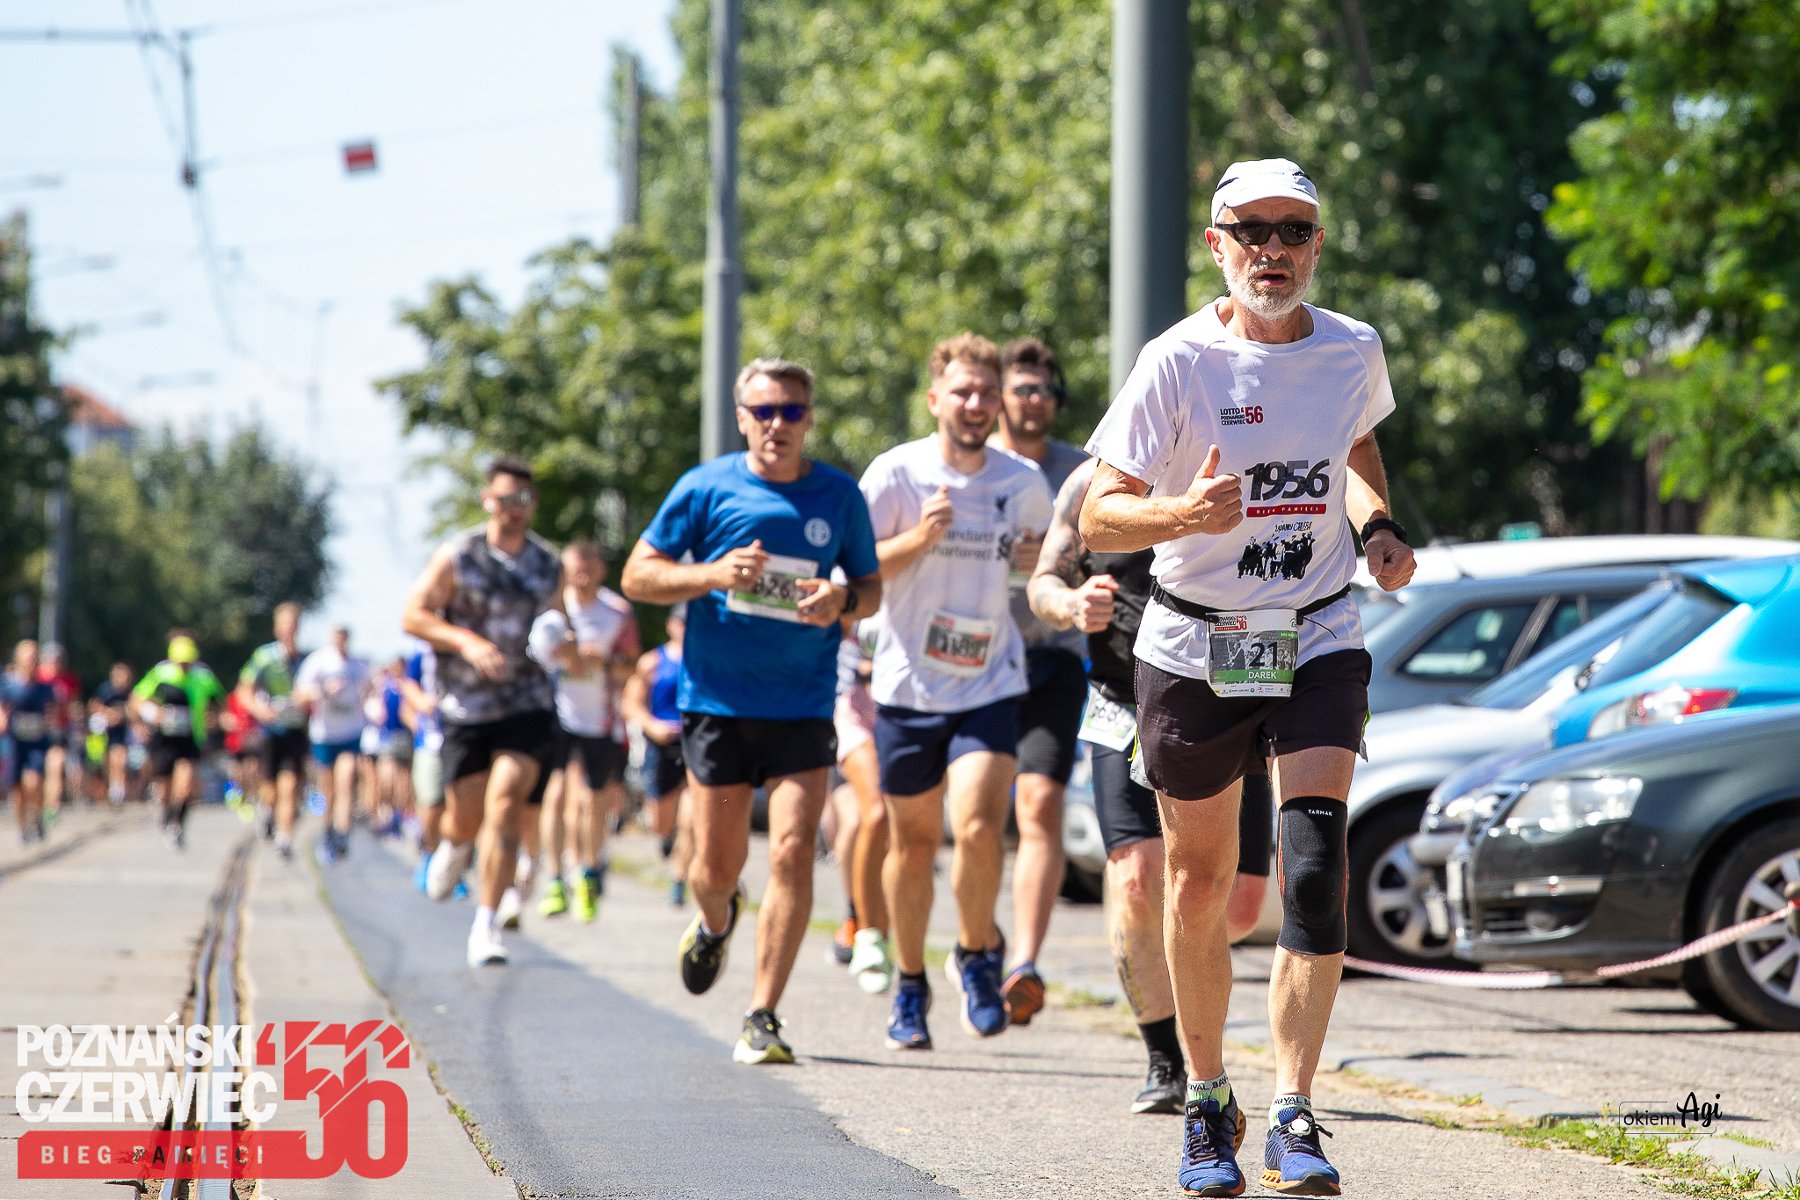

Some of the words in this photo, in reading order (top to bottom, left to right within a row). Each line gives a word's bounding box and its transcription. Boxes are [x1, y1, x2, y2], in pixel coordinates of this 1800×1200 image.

[1245, 459, 1330, 501] 1956
[1249, 642, 1278, 668] 21
[1248, 671, 1277, 680] DAREK
